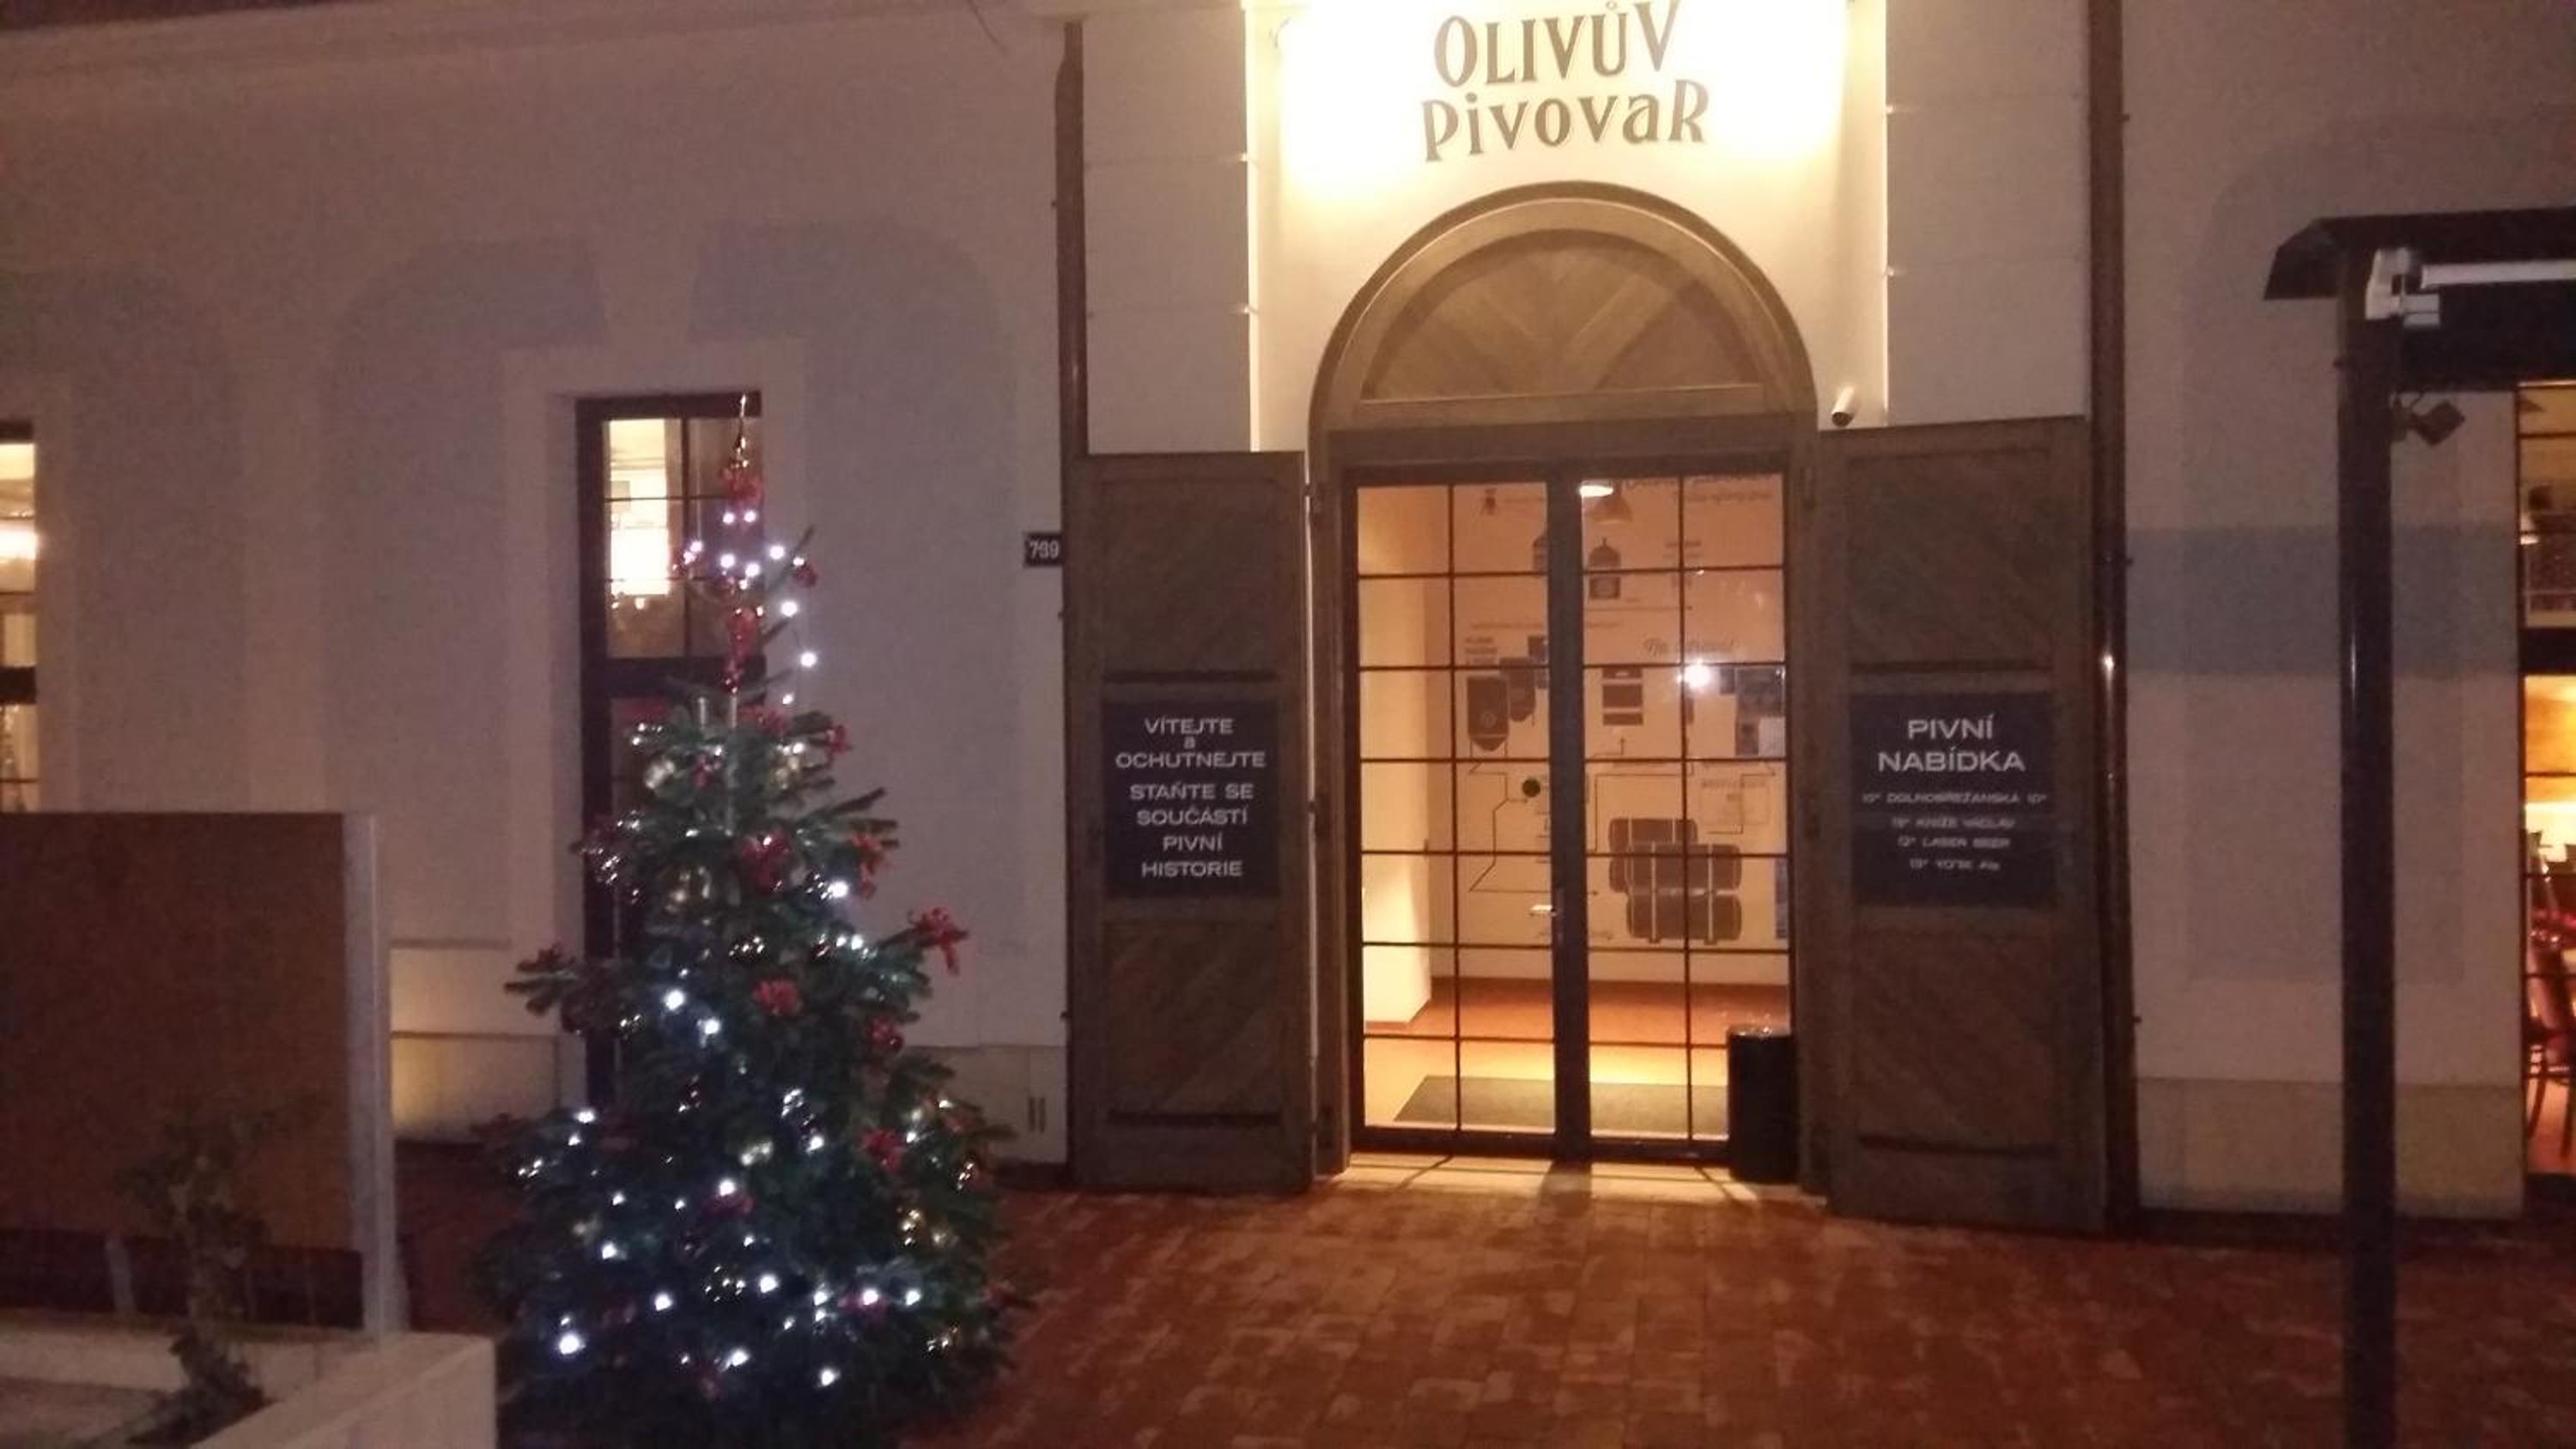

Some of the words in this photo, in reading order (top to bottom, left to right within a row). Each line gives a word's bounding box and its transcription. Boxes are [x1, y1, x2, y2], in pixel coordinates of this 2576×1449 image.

[1433, 0, 1680, 88] OLIVŮV
[1144, 716, 1234, 735] VÍTEJTE
[1907, 714, 1995, 740] PIVNÍ
[1115, 752, 1267, 768] OCHUTNEJTE
[1878, 745, 2026, 773] NABÍDKA
[1130, 780, 1216, 800] STAŇTE
[1225, 783, 1255, 799] SE
[1136, 803, 1249, 826] SOUČÁSTÍ
[1163, 830, 1224, 852] PIVNÍ
[1141, 860, 1244, 877] HISTORIE
